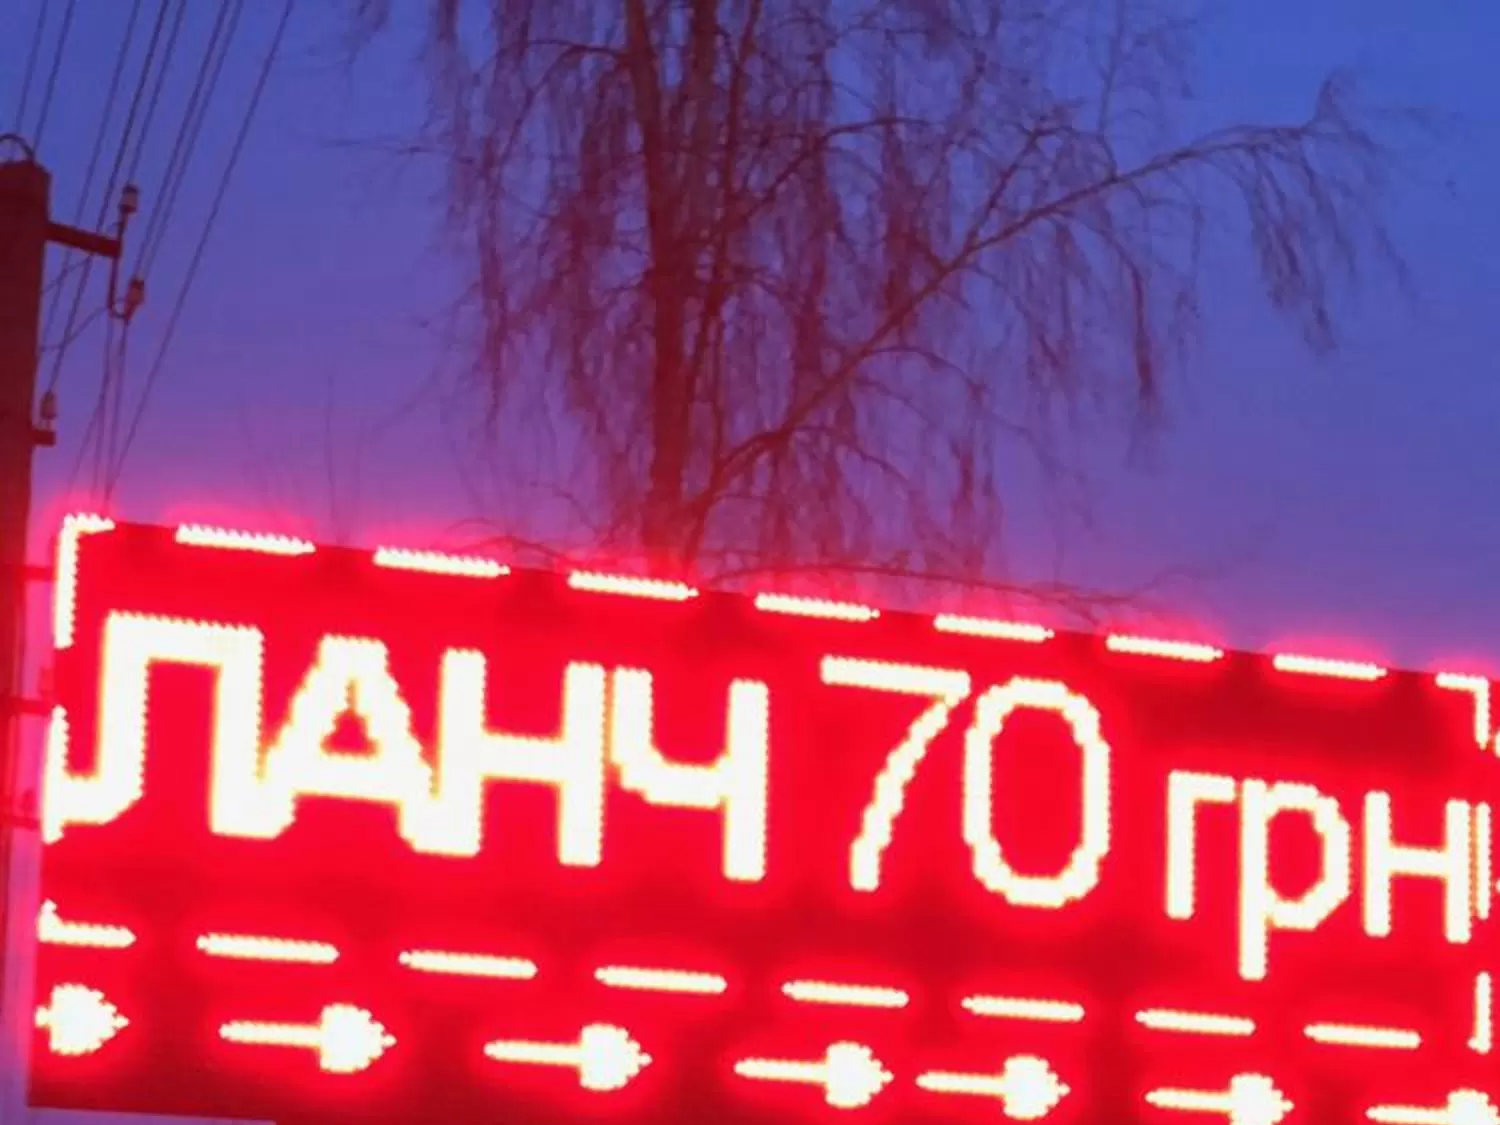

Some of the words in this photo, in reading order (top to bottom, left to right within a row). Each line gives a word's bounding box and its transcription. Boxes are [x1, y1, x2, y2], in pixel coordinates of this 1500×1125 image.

[46, 611, 769, 881] ЛАНЧ
[822, 656, 1110, 907] 70
[1166, 770, 1473, 980] грн
